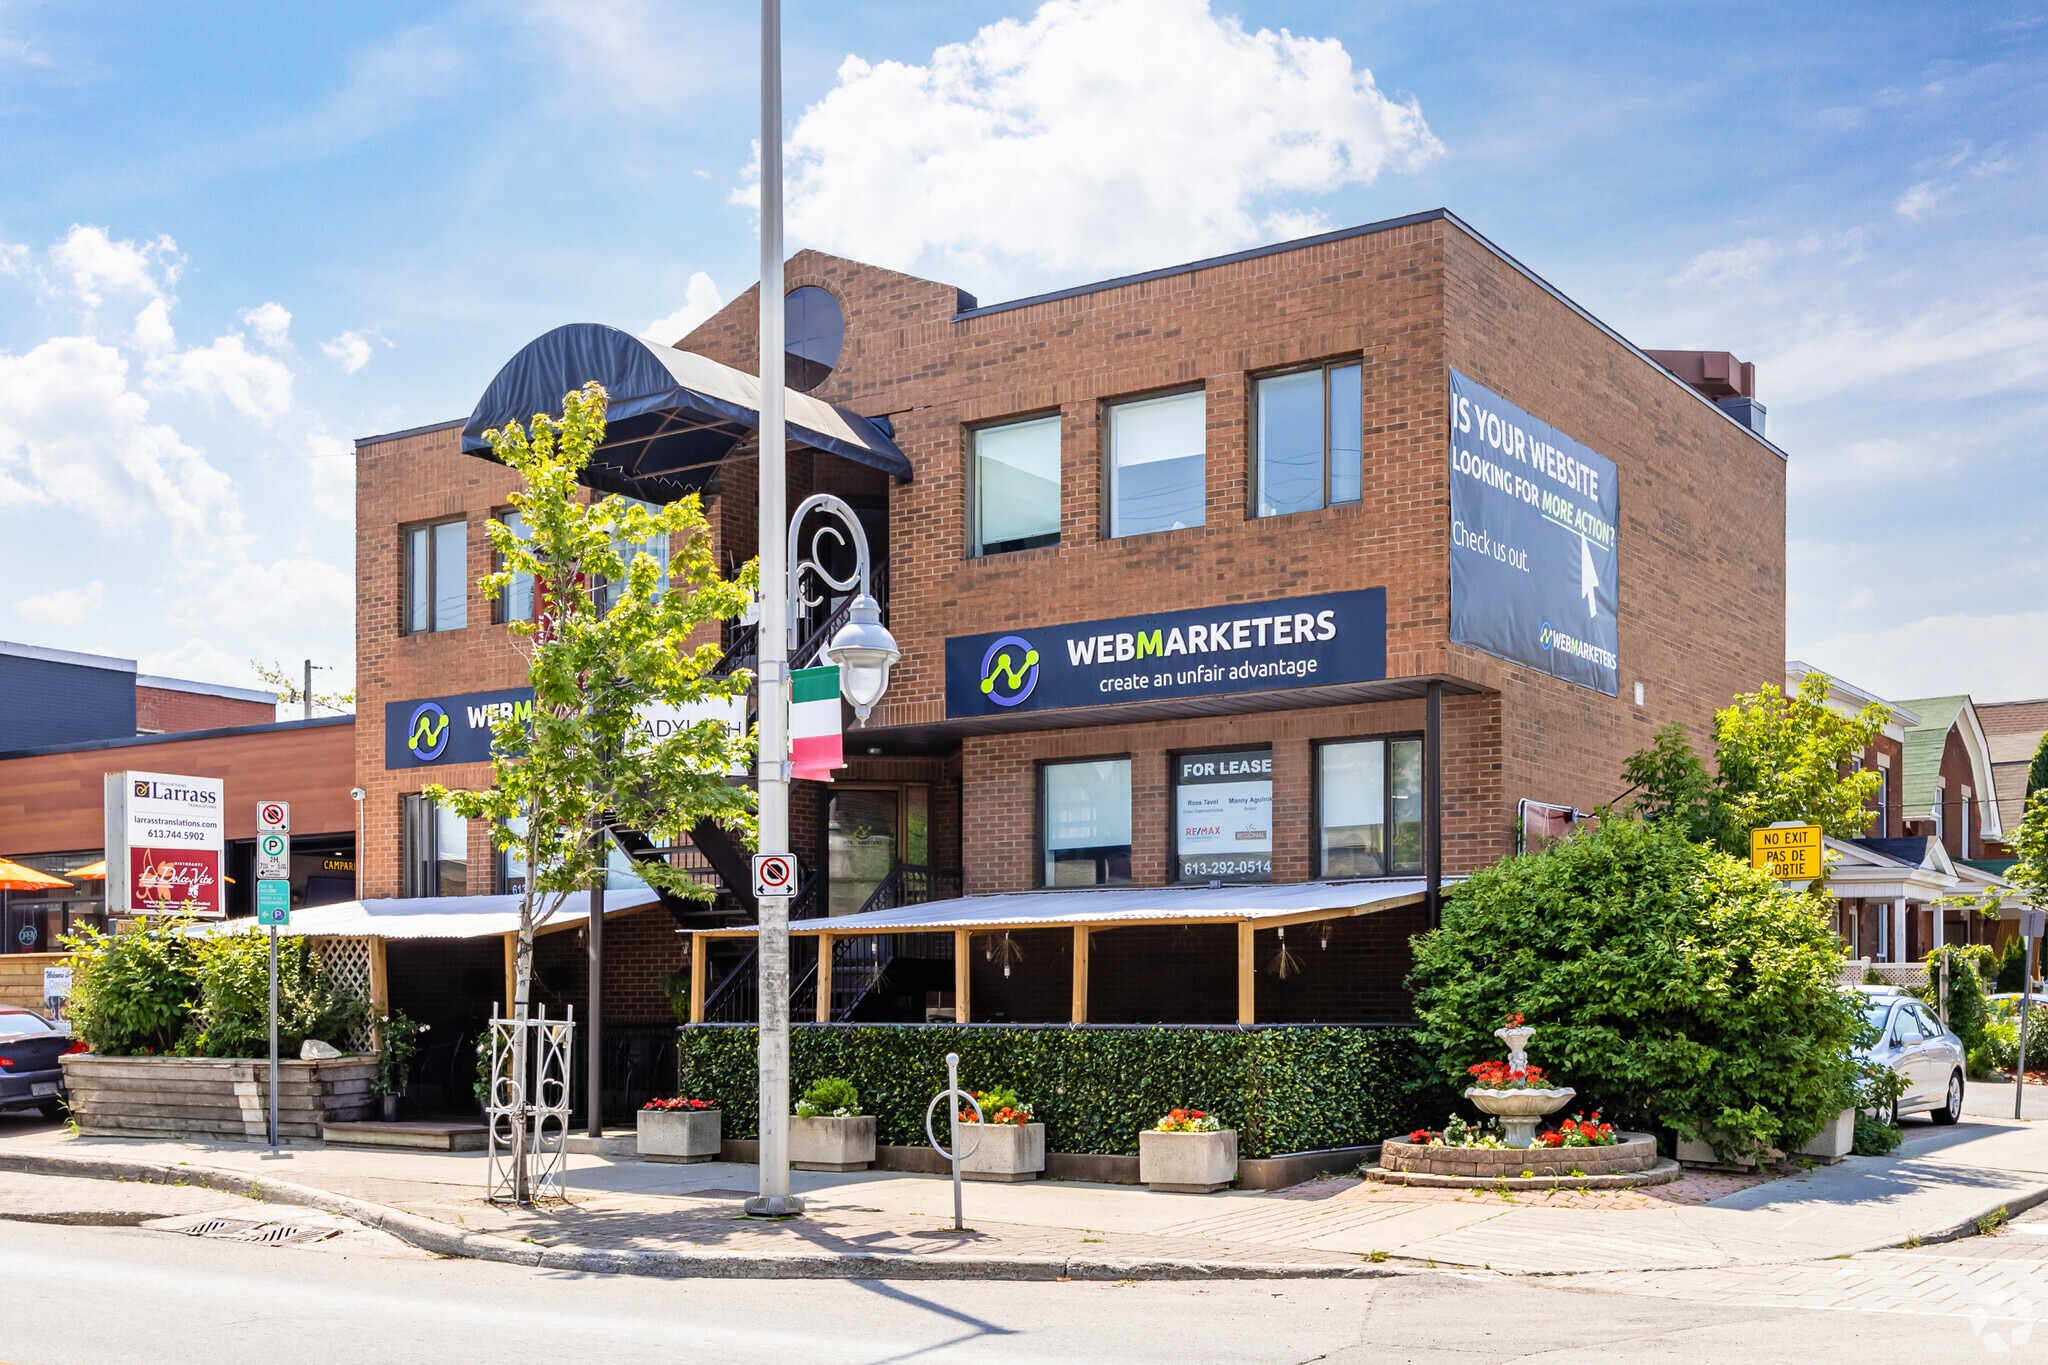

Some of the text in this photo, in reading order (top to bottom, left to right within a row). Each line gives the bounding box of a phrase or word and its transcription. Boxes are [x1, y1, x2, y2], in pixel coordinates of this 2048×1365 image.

[1452, 392, 1599, 502] IS YOUR WEBSITE
[1452, 445, 1512, 496] LOOKING
[1515, 478, 1539, 508] FOR
[1542, 490, 1573, 525] MORE
[1452, 521, 1530, 573] Check us out.
[1067, 610, 1337, 666] WEBMARKETERS
[1553, 629, 1617, 671] WEBMARKETERS
[1100, 658, 1317, 692] create an unfair advantage
[1183, 759, 1272, 777] FOR LEASE
[152, 782, 216, 804] Larrass
[134, 816, 217, 828] larrasstranslations.com
[148, 829, 205, 841] 613.744.5902
[1186, 827, 1220, 836] RE/MAX
[1764, 832, 1808, 845] NO EXIT
[1767, 850, 1806, 862] PAS DE
[139, 865, 214, 884] La Dolce Vita
[323, 860, 356, 871] CAMPARI
[1185, 861, 1271, 875] 613-292-0514
[20, 931, 36, 940] OPEN
